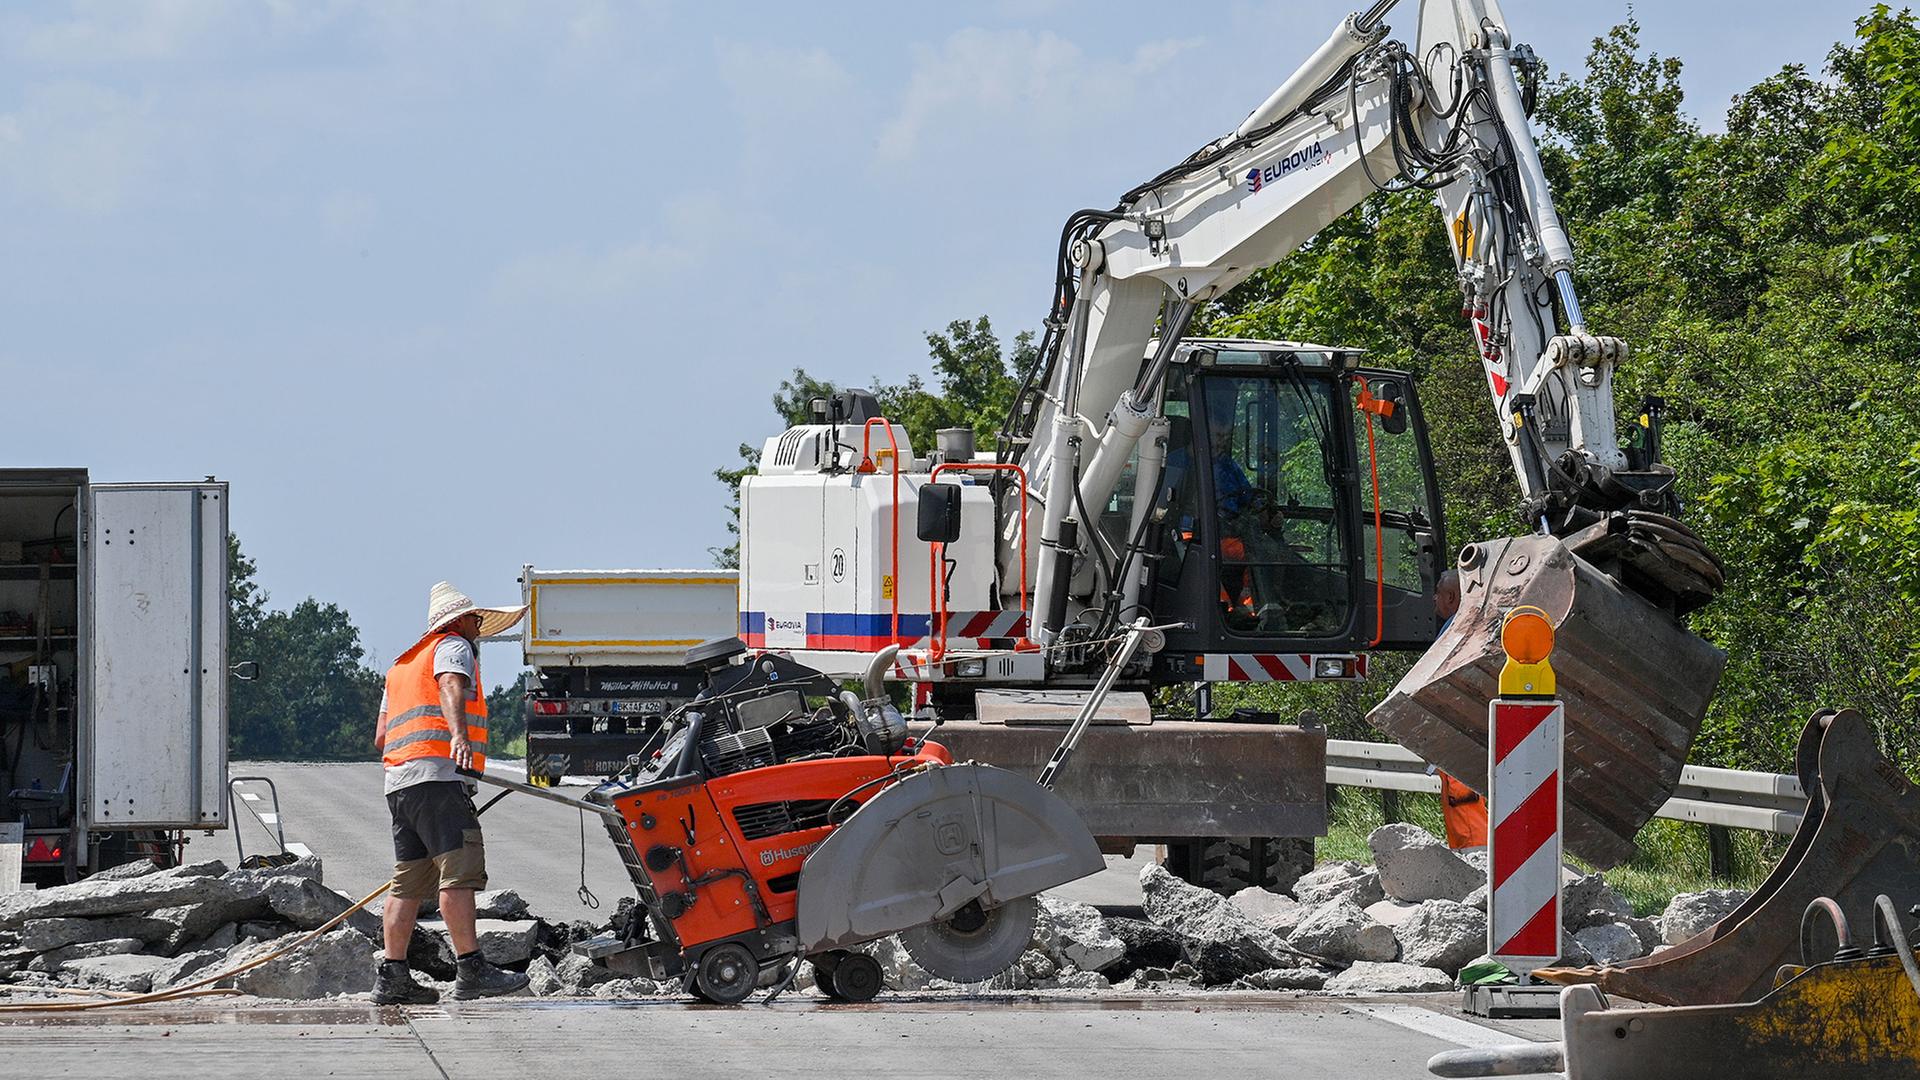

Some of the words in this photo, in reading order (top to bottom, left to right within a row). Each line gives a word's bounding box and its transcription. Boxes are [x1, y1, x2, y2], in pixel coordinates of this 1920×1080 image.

[1264, 141, 1322, 183] EUROVIA
[833, 554, 844, 577] 20
[775, 621, 802, 629] EUROVIA
